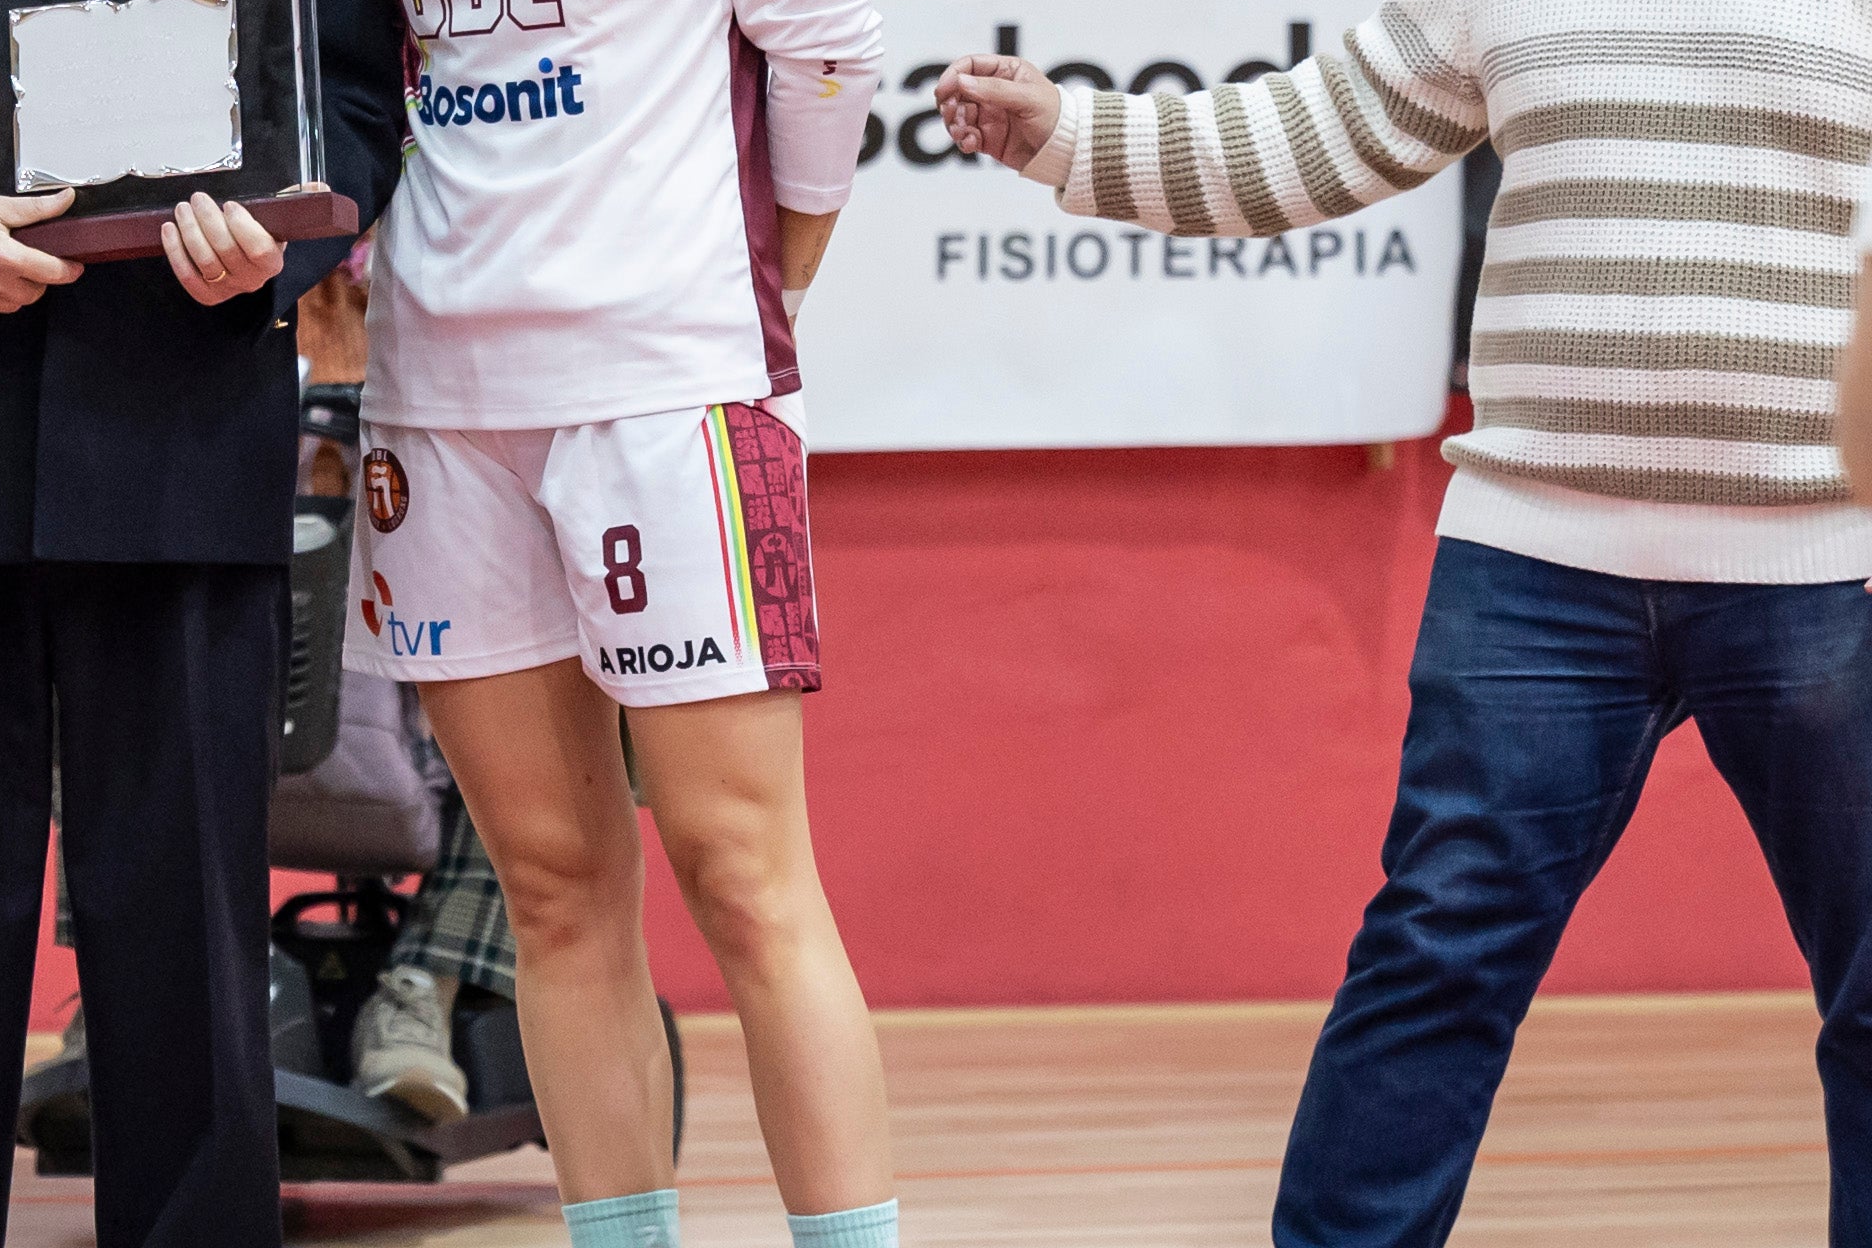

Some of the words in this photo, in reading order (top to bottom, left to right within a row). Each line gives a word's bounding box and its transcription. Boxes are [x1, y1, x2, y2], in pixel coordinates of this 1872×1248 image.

[935, 227, 1419, 283] FISIOTERAPIA
[601, 523, 649, 616] 8
[387, 611, 452, 657] tvr
